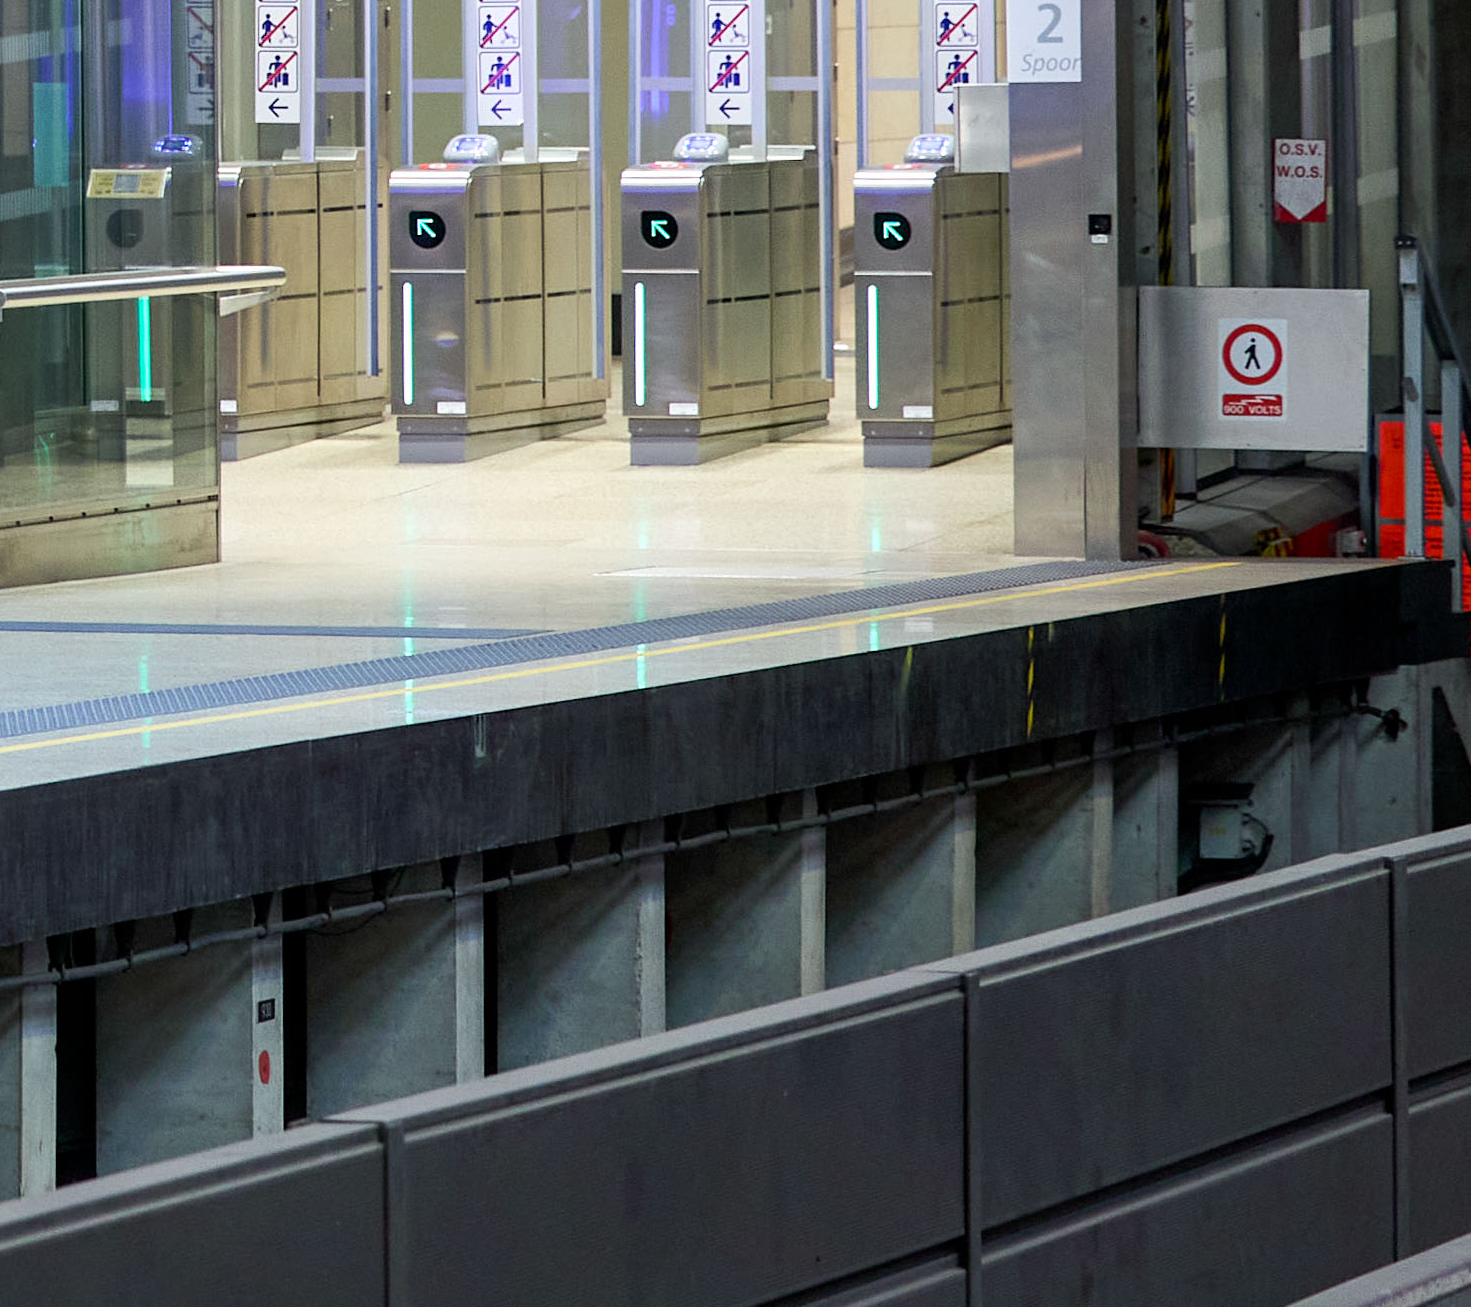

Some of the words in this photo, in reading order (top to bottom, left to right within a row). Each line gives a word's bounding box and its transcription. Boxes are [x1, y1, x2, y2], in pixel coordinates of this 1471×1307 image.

[1036, 3, 1063, 43] 2
[1021, 53, 1082, 77] Spoor
[1279, 142, 1322, 156] O.S.V.
[1276, 165, 1323, 178] W.O.S.
[1224, 404, 1245, 414] 900
[1248, 404, 1282, 415] VOLTS
